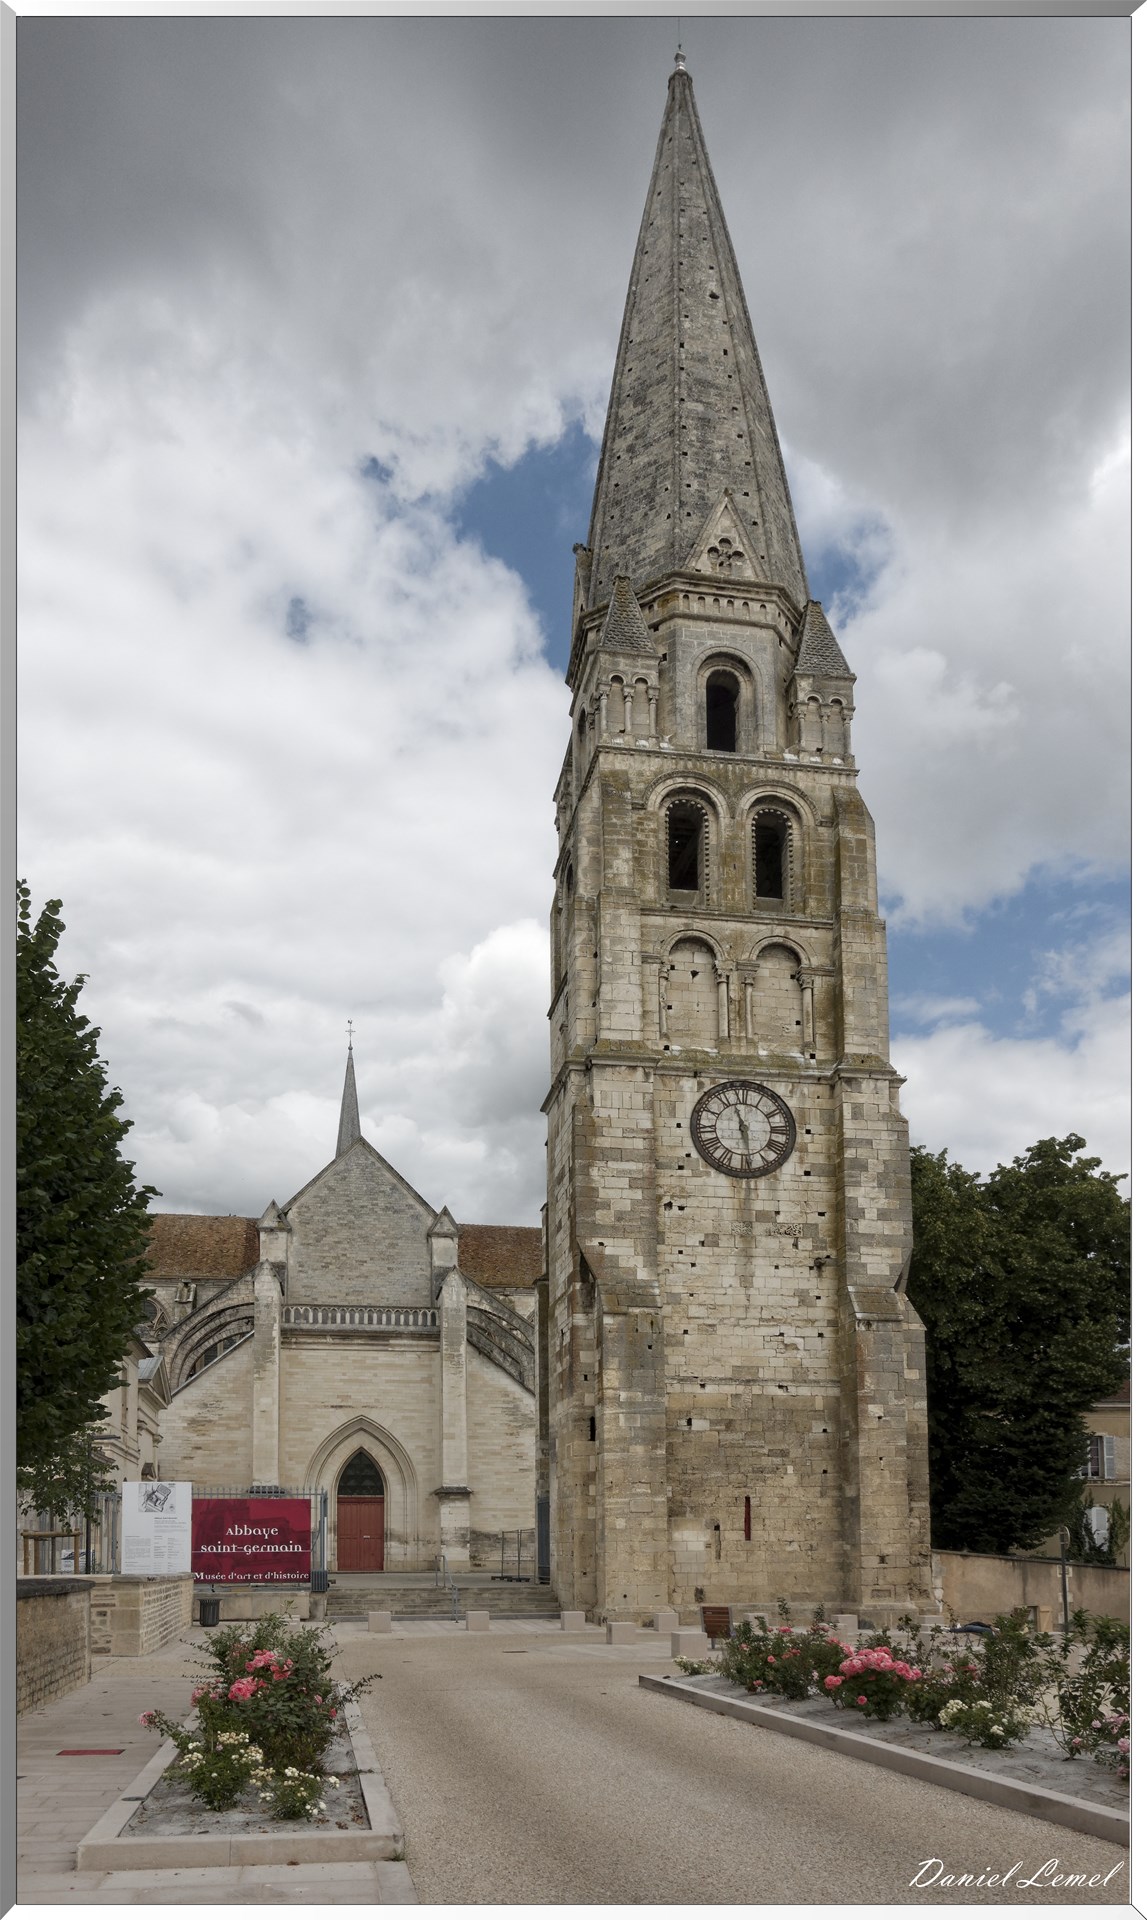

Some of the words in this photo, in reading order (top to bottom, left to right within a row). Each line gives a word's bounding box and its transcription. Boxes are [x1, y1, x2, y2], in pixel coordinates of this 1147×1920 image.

[714, 1091, 730, 1109] XI
[734, 1089, 748, 1104] XII
[703, 1106, 719, 1118] X
[766, 1108, 782, 1119] II
[699, 1123, 716, 1133] IX
[770, 1125, 788, 1136] III
[758, 1152, 770, 1166] V
[225, 1524, 279, 1540] Abbaye
[200, 1540, 302, 1555] saint-germain
[193, 1571, 226, 1580] Musée
[227, 1572, 252, 1580] d'art
[264, 1570, 309, 1579] d'histoire
